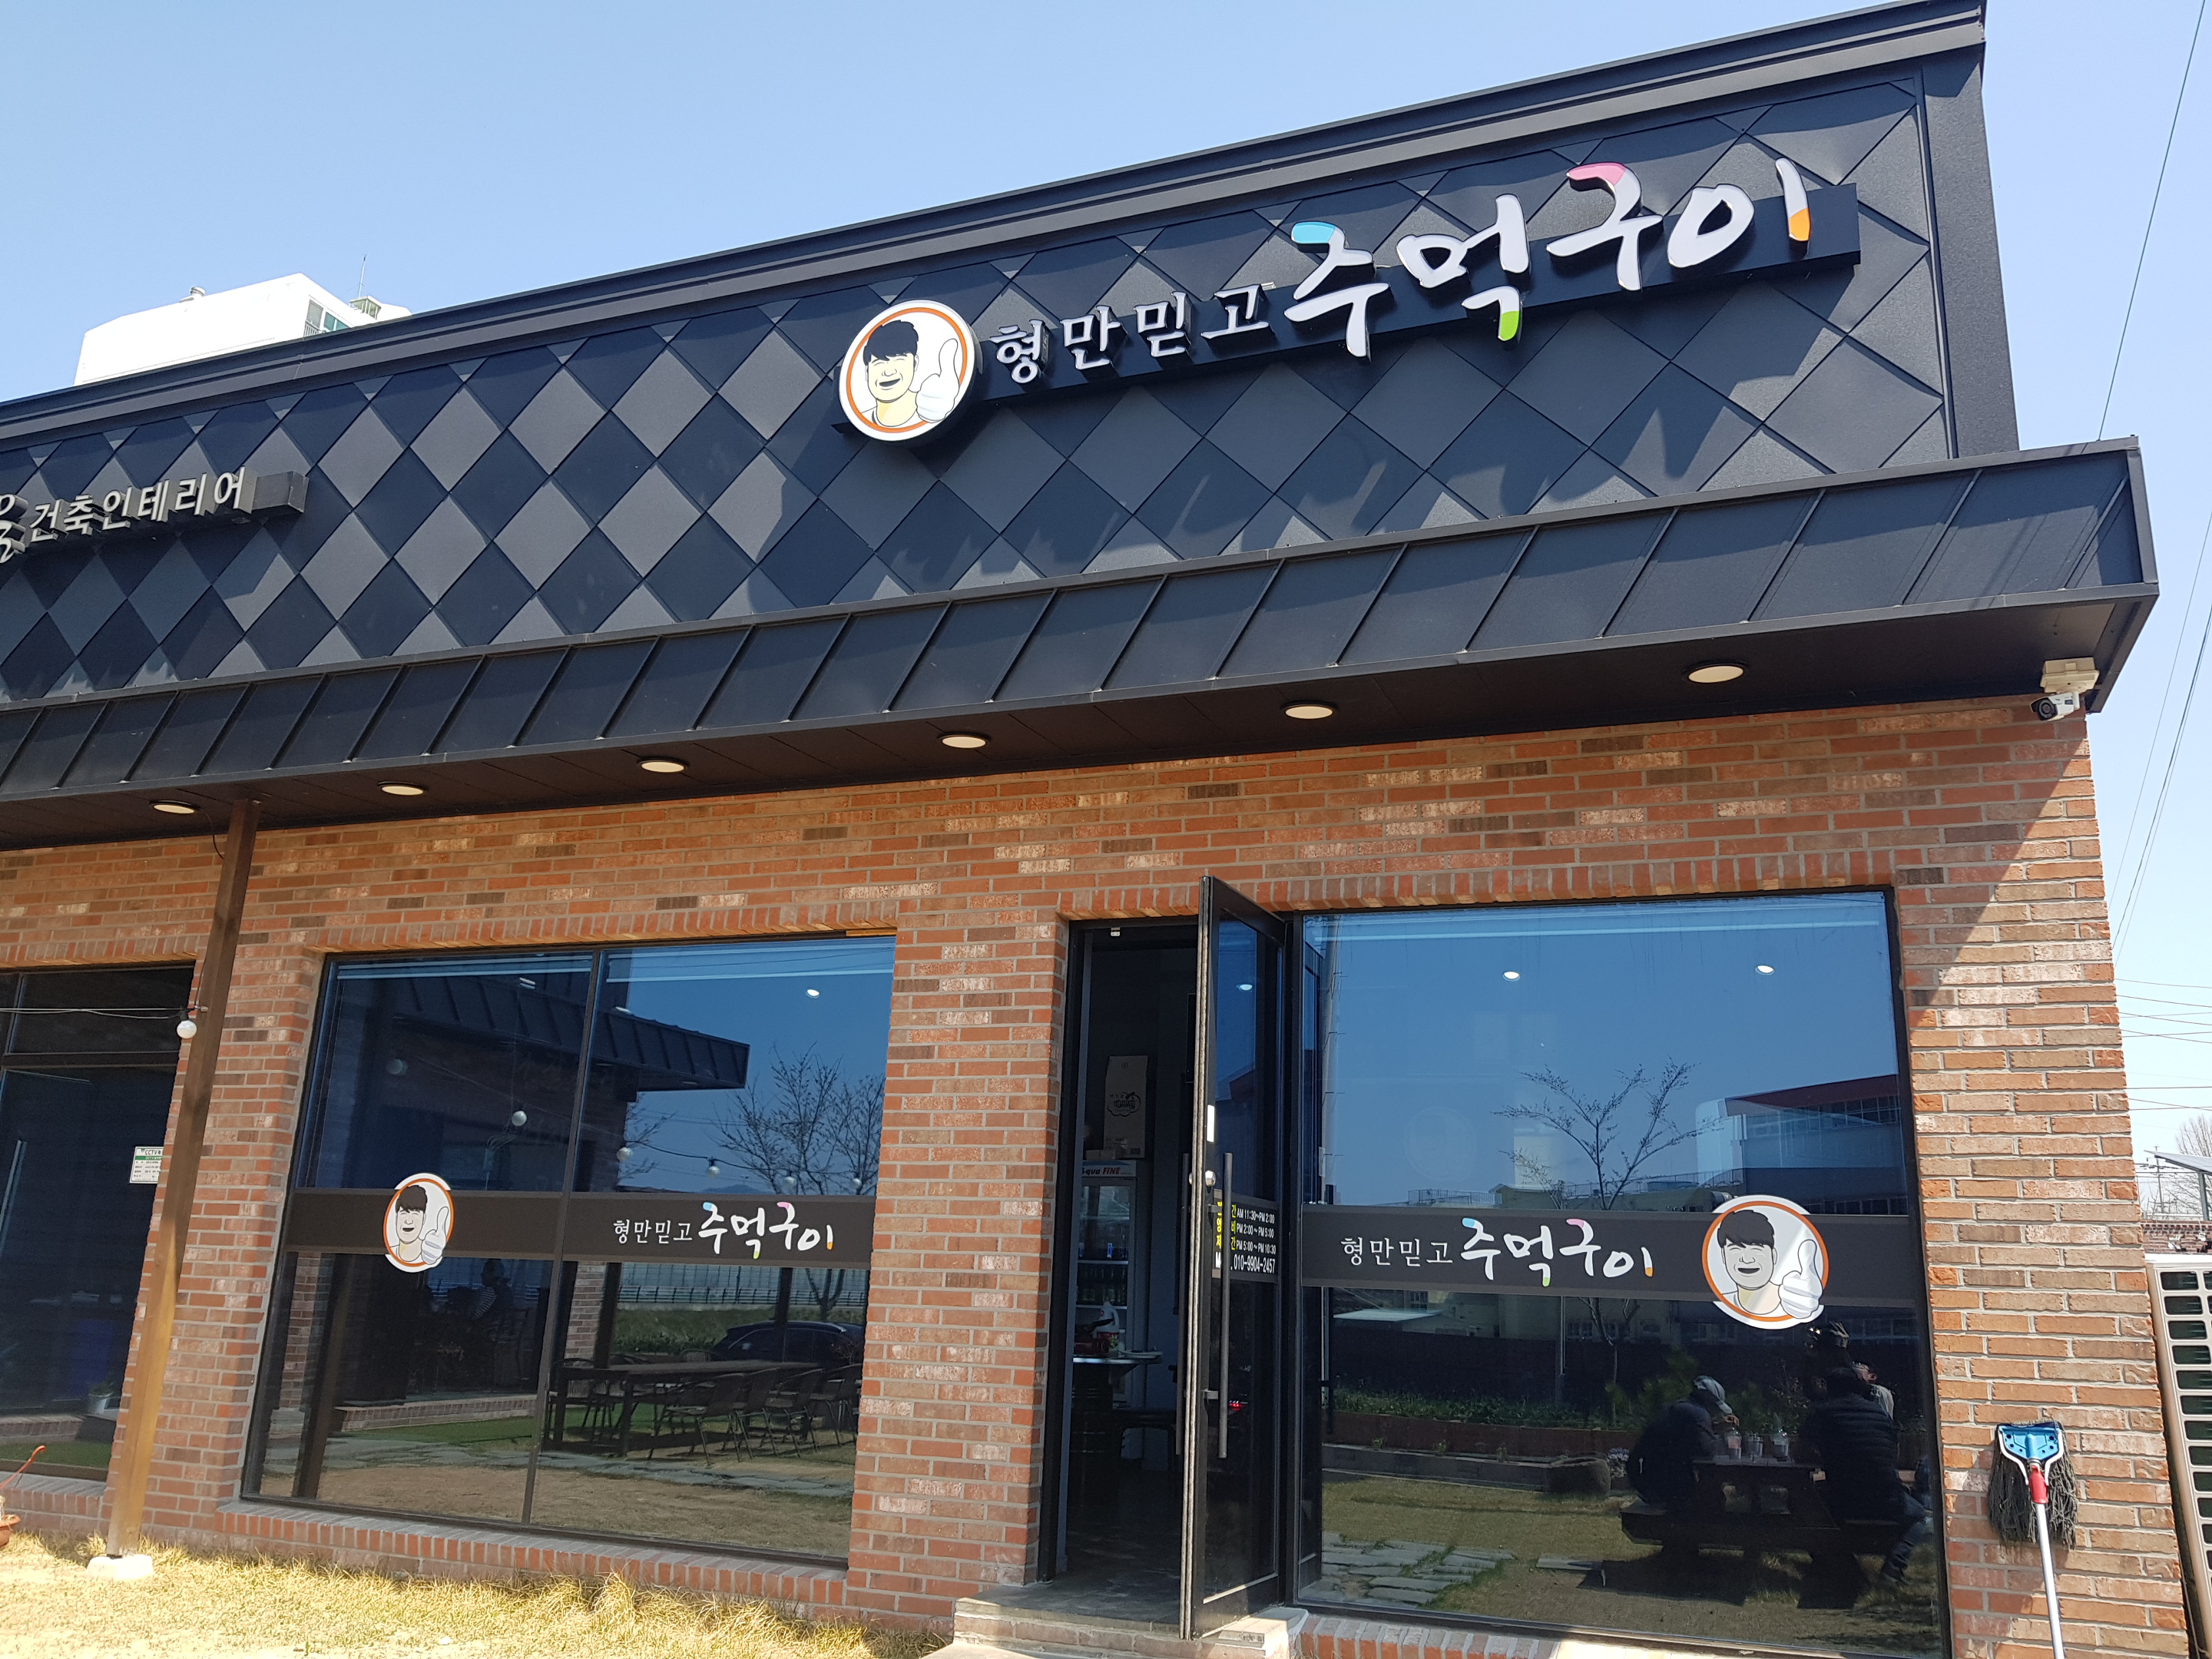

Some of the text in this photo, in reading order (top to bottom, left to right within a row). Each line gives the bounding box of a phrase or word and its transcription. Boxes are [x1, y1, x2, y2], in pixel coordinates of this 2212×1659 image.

[988, 157, 1811, 386] 형만믿고 주먹구이
[1102, 1167, 1121, 1175] FINE
[1237, 1208, 1243, 1219] AM
[1266, 1214, 1275, 1224] 2:00
[614, 1201, 834, 1260] 형만믿고 주먹구이
[1237, 1223, 1243, 1233] PM
[1243, 1224, 1253, 1235] 2:00
[1258, 1226, 1264, 1237] PM
[1265, 1227, 1274, 1239] 5:00
[1236, 1239, 1243, 1250] PM
[1243, 1241, 1253, 1252] 5:00
[1257, 1243, 1264, 1253] PM
[1264, 1245, 1277, 1255] 10:30
[1340, 1217, 1654, 1286] 형만믿고 주먹구이
[1233, 1253, 1275, 1273] 010-9904-2457
